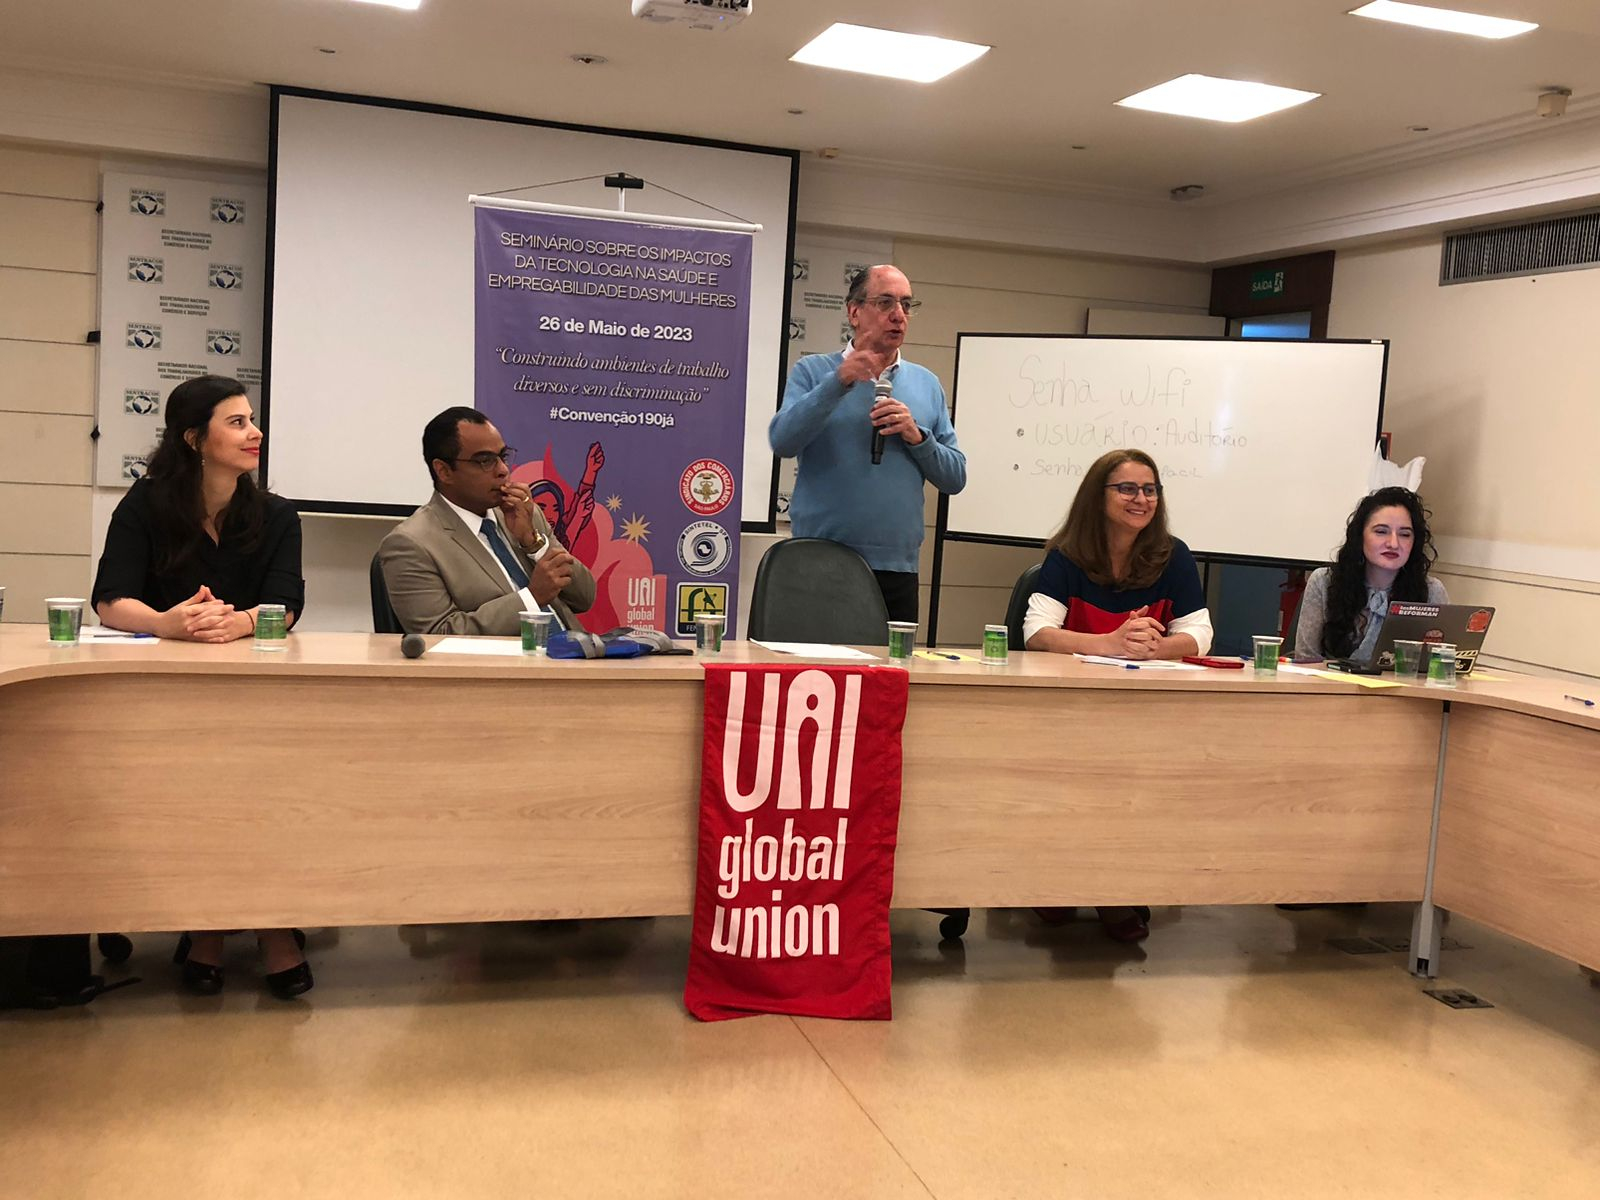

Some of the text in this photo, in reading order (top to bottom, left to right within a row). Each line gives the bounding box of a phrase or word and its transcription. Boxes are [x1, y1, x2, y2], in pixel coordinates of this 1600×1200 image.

[500, 231, 732, 267] SEMINÁRIO SOBRE OS IMPACTOS
[514, 254, 718, 286] DA TECNOLOGIA NA SAÚDE E
[488, 273, 737, 308] EMPREGABILIDADE DAS MULHERES
[539, 316, 693, 341] 26 de Maio de 2023
[495, 346, 730, 379] “Construindo ambientes de trabalho
[513, 374, 710, 405] diversos e sem discriminação”
[1008, 354, 1100, 408] Senha
[550, 406, 675, 428] #Convenção190já
[692, 461, 706, 473] DOS
[685, 522, 713, 535] SINTETEL
[626, 607, 655, 624] global
[717, 817, 849, 900] global
[710, 889, 841, 959] union
